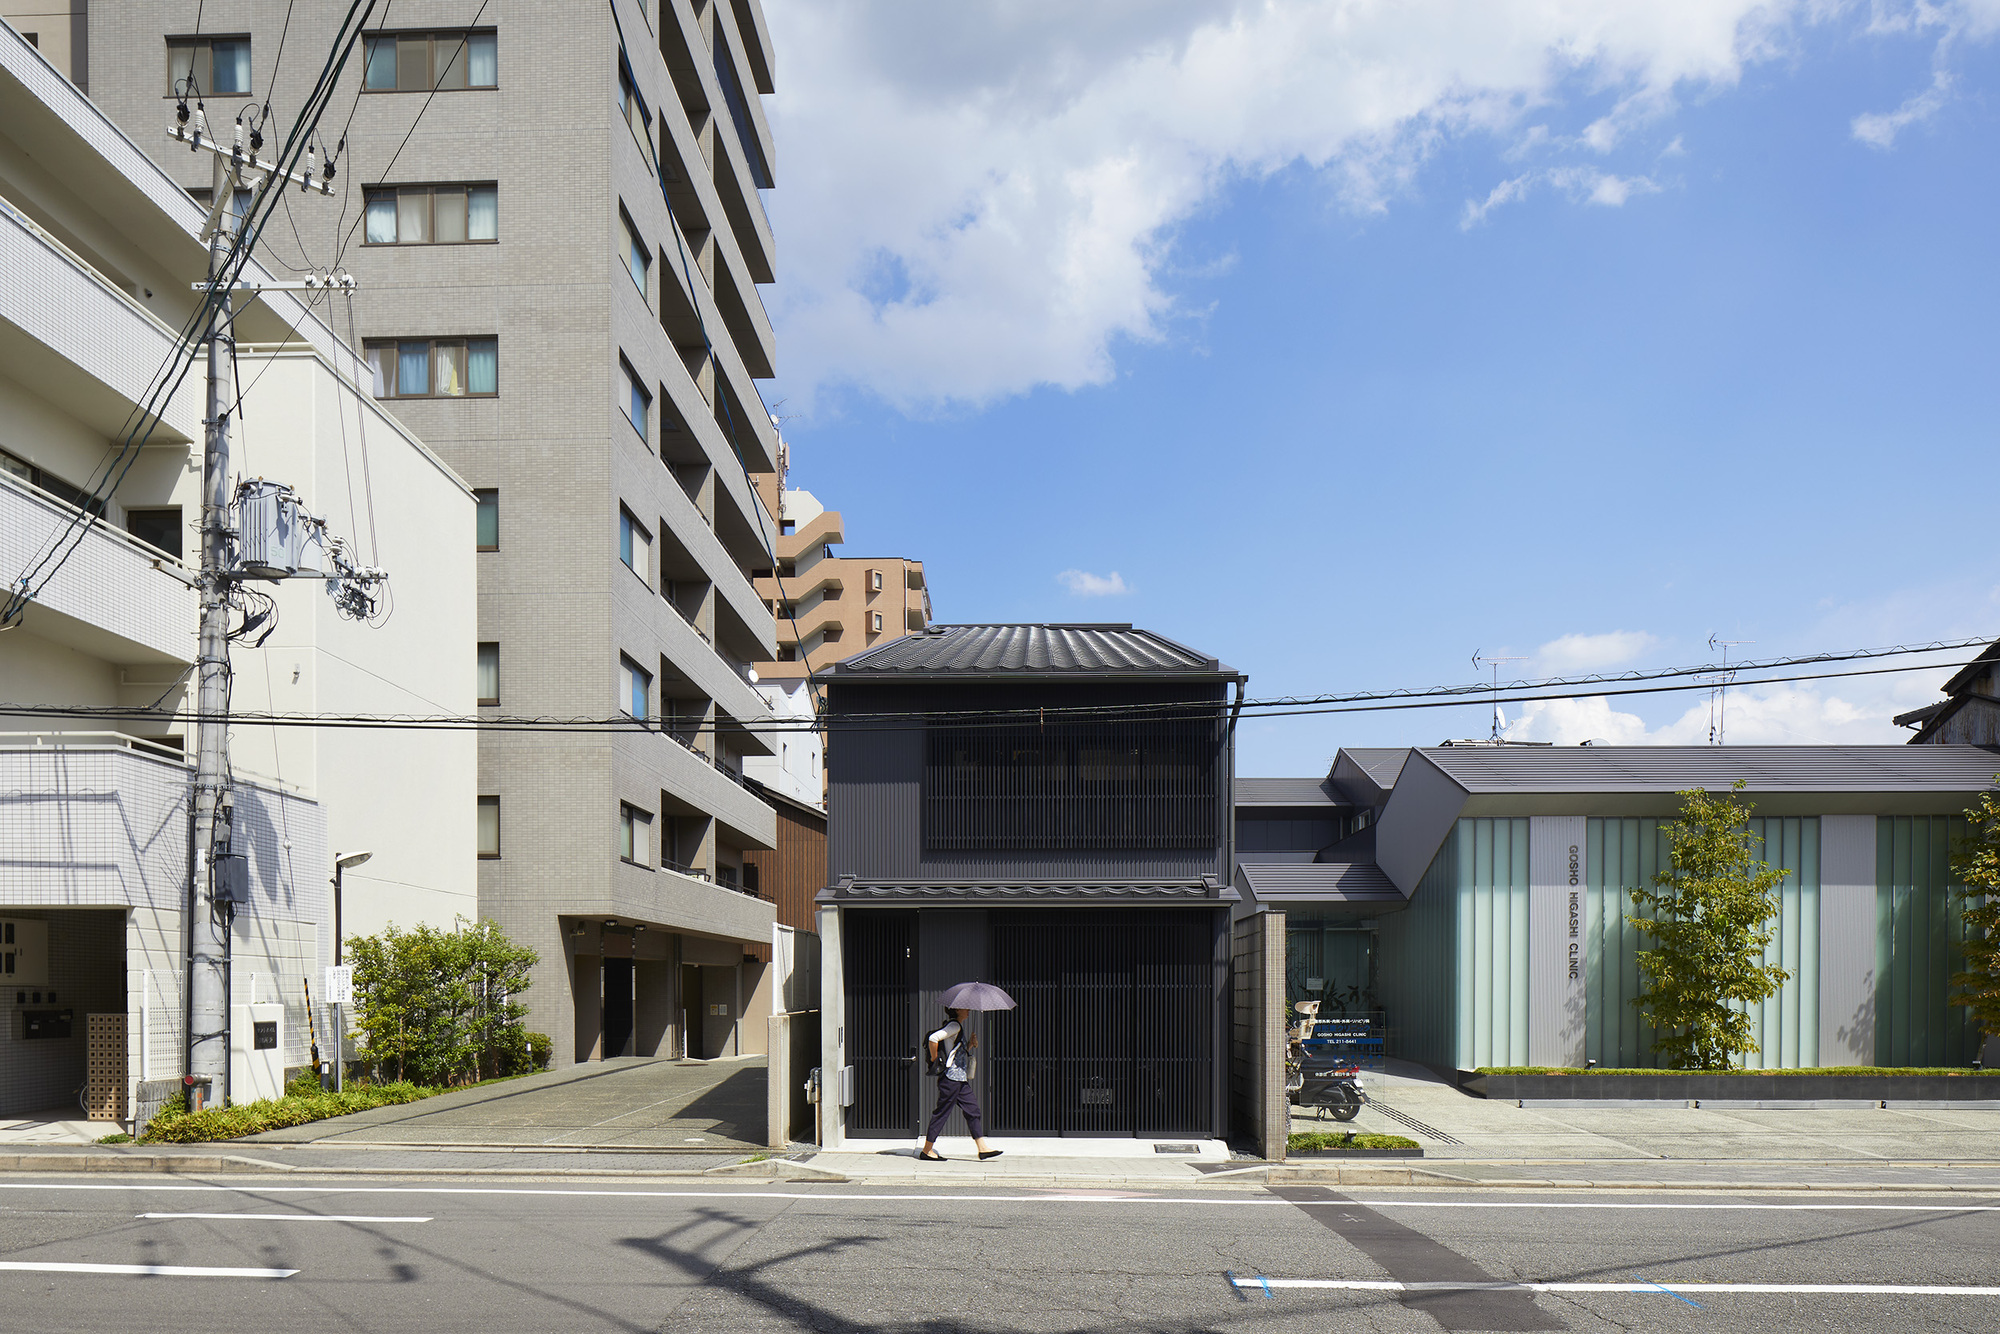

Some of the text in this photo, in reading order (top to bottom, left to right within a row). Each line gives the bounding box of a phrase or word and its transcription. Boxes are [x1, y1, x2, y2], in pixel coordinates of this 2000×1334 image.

[1569, 844, 1579, 979] GOSHO HIGASHI CLINIC
